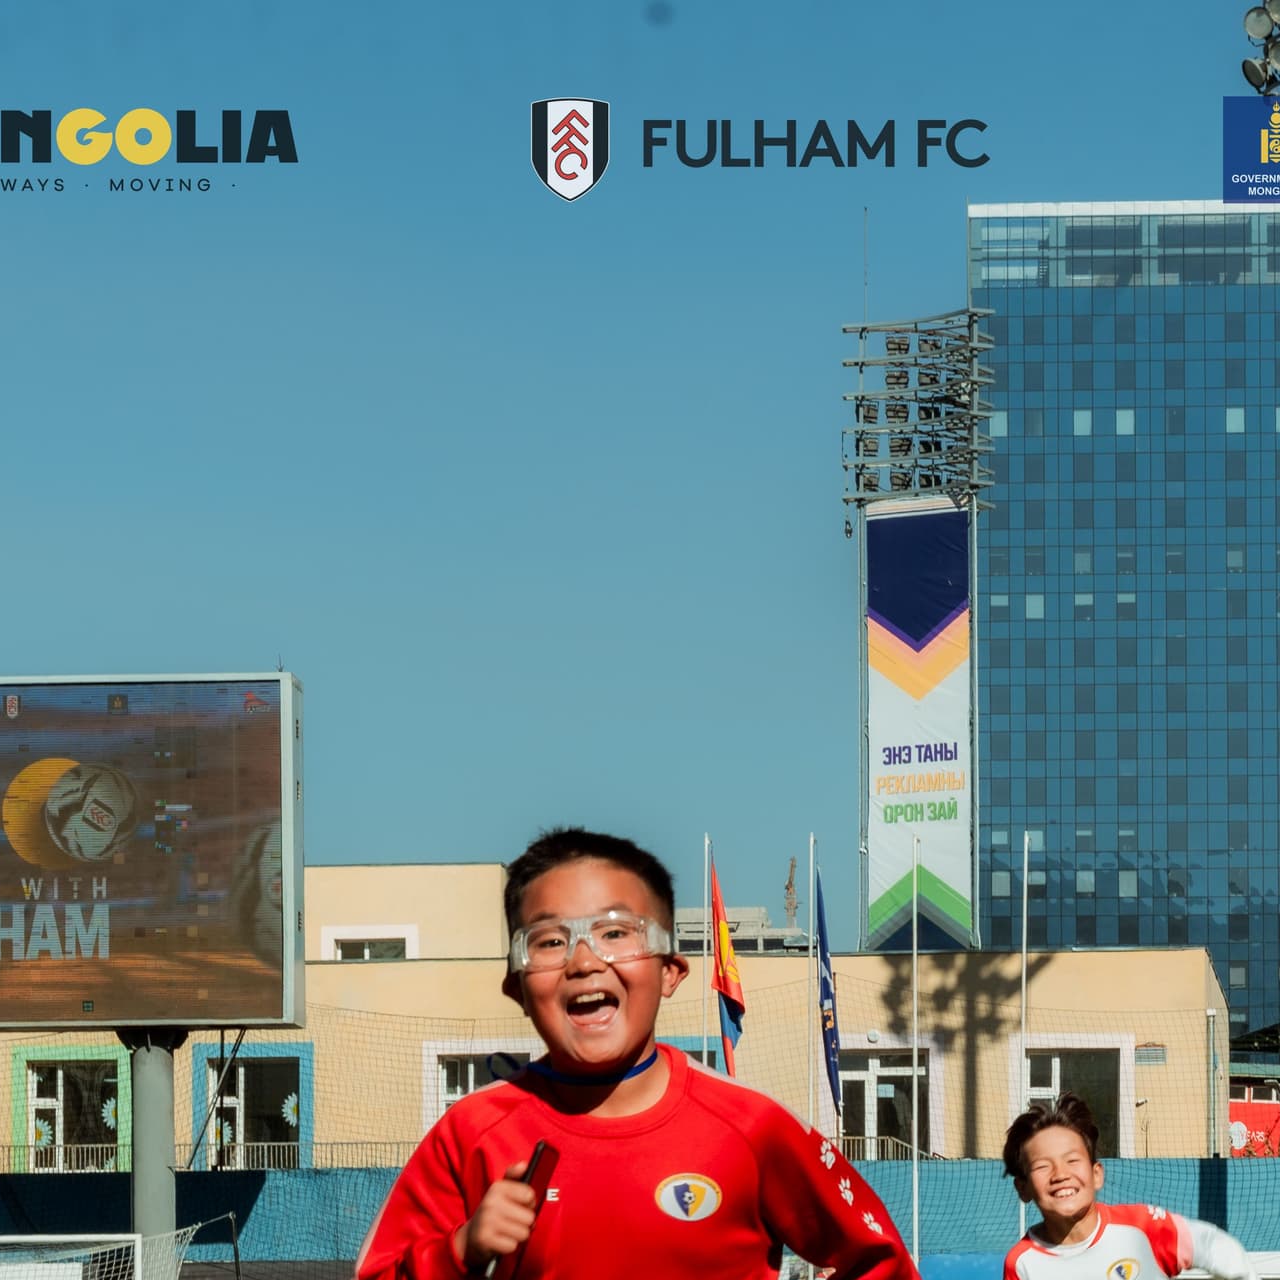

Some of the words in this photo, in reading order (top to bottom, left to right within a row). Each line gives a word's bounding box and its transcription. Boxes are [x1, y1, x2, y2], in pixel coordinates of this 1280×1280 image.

[882, 745, 912, 765] ЭНЭ
[915, 742, 957, 763] ТАНЫ
[883, 802, 924, 824] ОРОН
[927, 797, 958, 821] ЗАЙ
[21, 877, 107, 900] WITH
